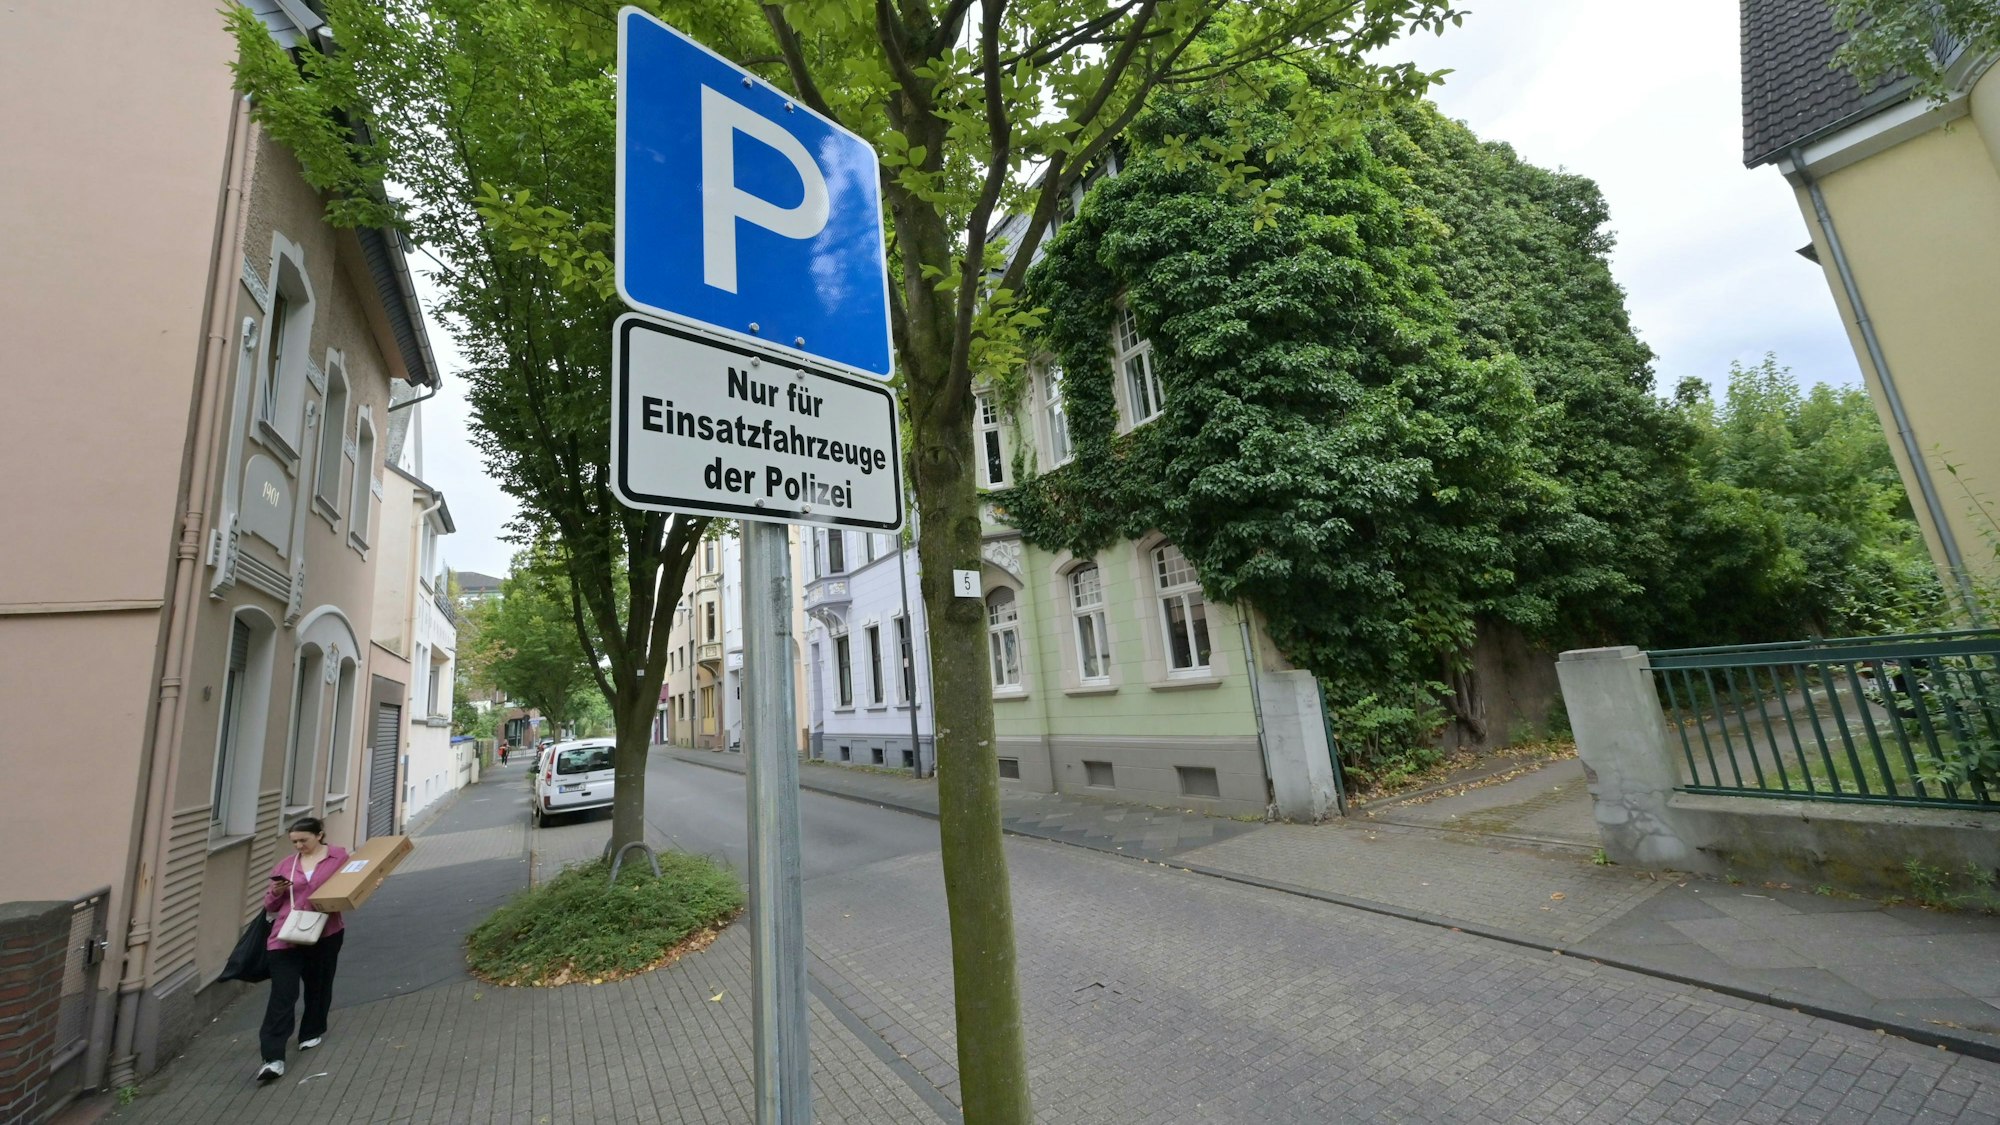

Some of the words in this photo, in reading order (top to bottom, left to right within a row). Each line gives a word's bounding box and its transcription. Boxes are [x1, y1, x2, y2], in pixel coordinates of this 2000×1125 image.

[701, 83, 830, 295] P
[727, 367, 779, 407] Nur
[787, 382, 823, 417] für
[642, 396, 886, 475] Einsatzfahrzeuge
[262, 481, 280, 507] 1901
[704, 456, 755, 494] der
[766, 465, 852, 509] Polizei
[964, 576, 971, 590] 5
